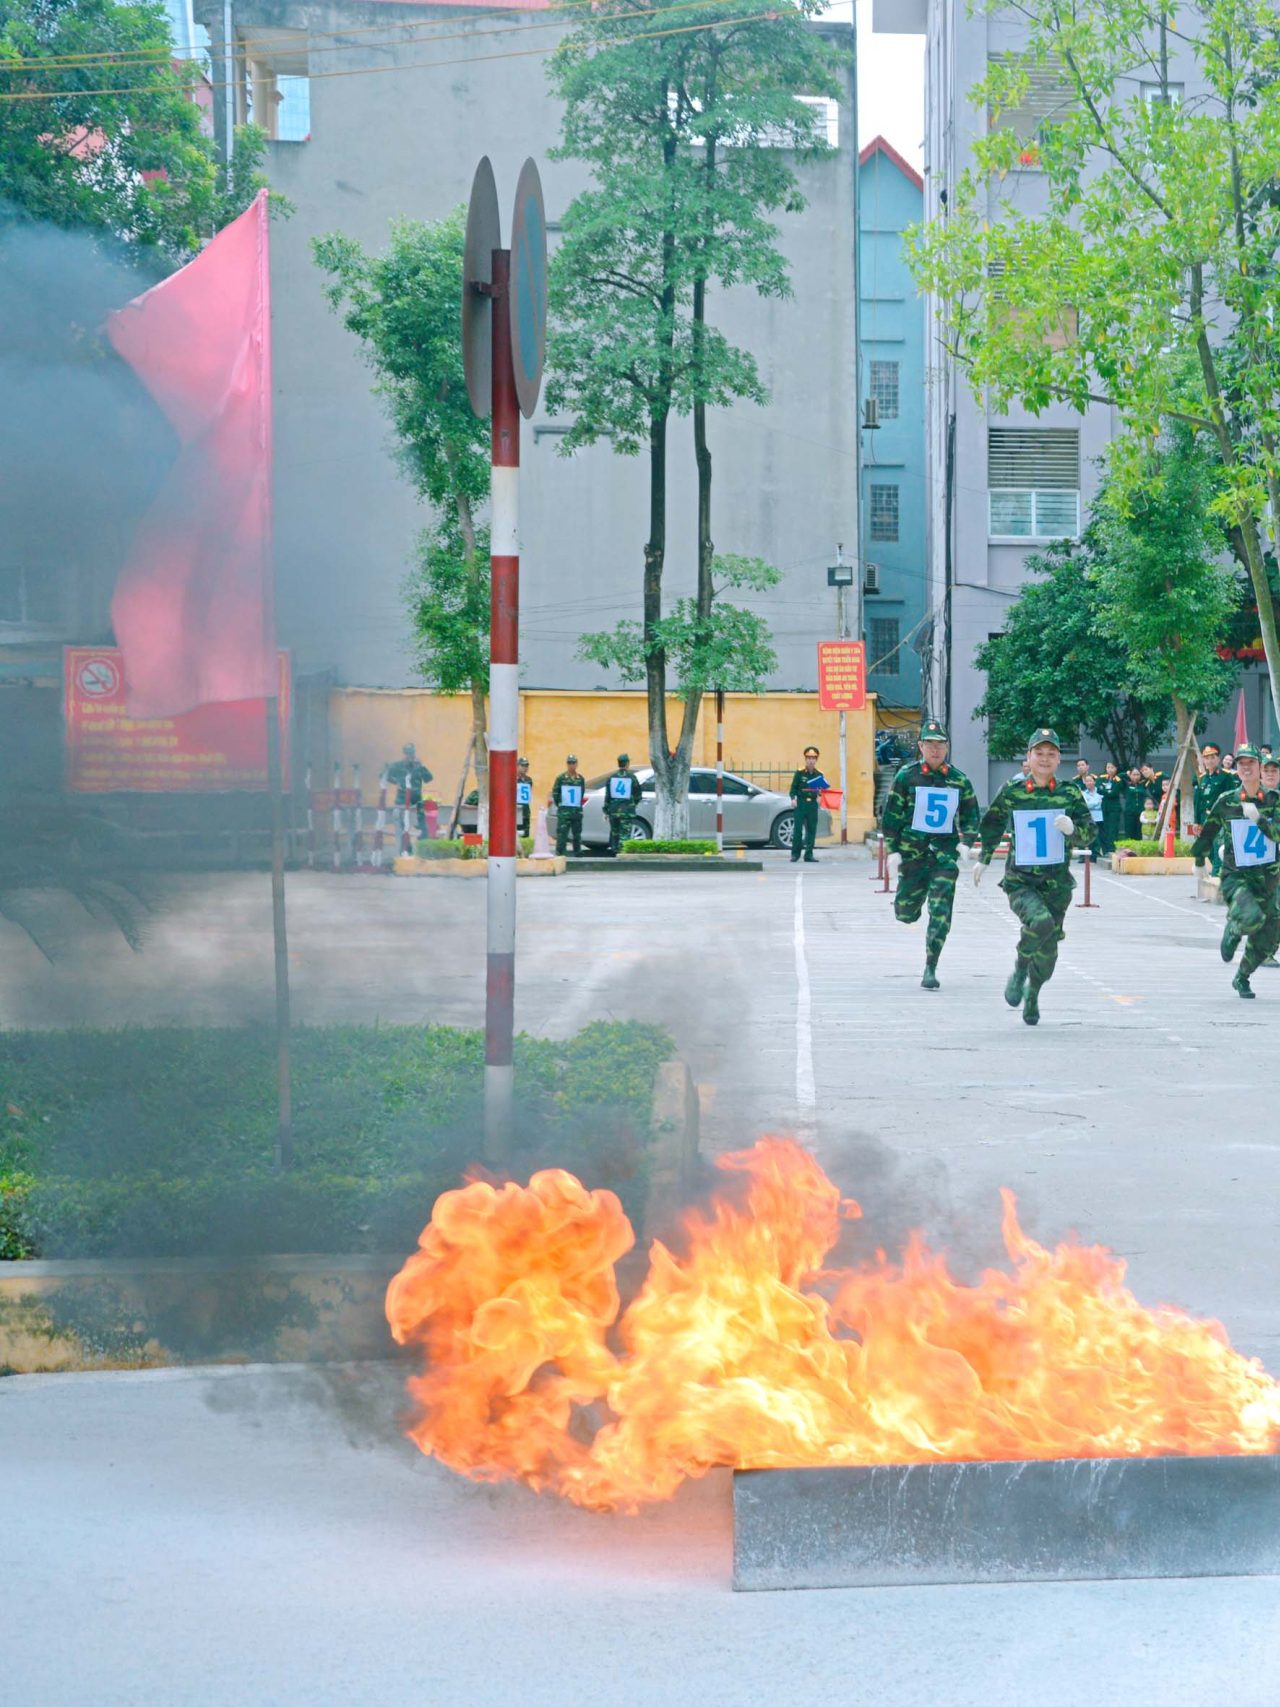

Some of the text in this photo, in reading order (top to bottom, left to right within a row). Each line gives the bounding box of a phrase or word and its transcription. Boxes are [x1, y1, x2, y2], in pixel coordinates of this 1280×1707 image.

[520, 786, 529, 801] 5
[567, 788, 575, 804] 1
[615, 781, 626, 796] 4
[924, 792, 949, 828] 5
[1028, 816, 1047, 858] 1
[1243, 825, 1268, 859] 4
